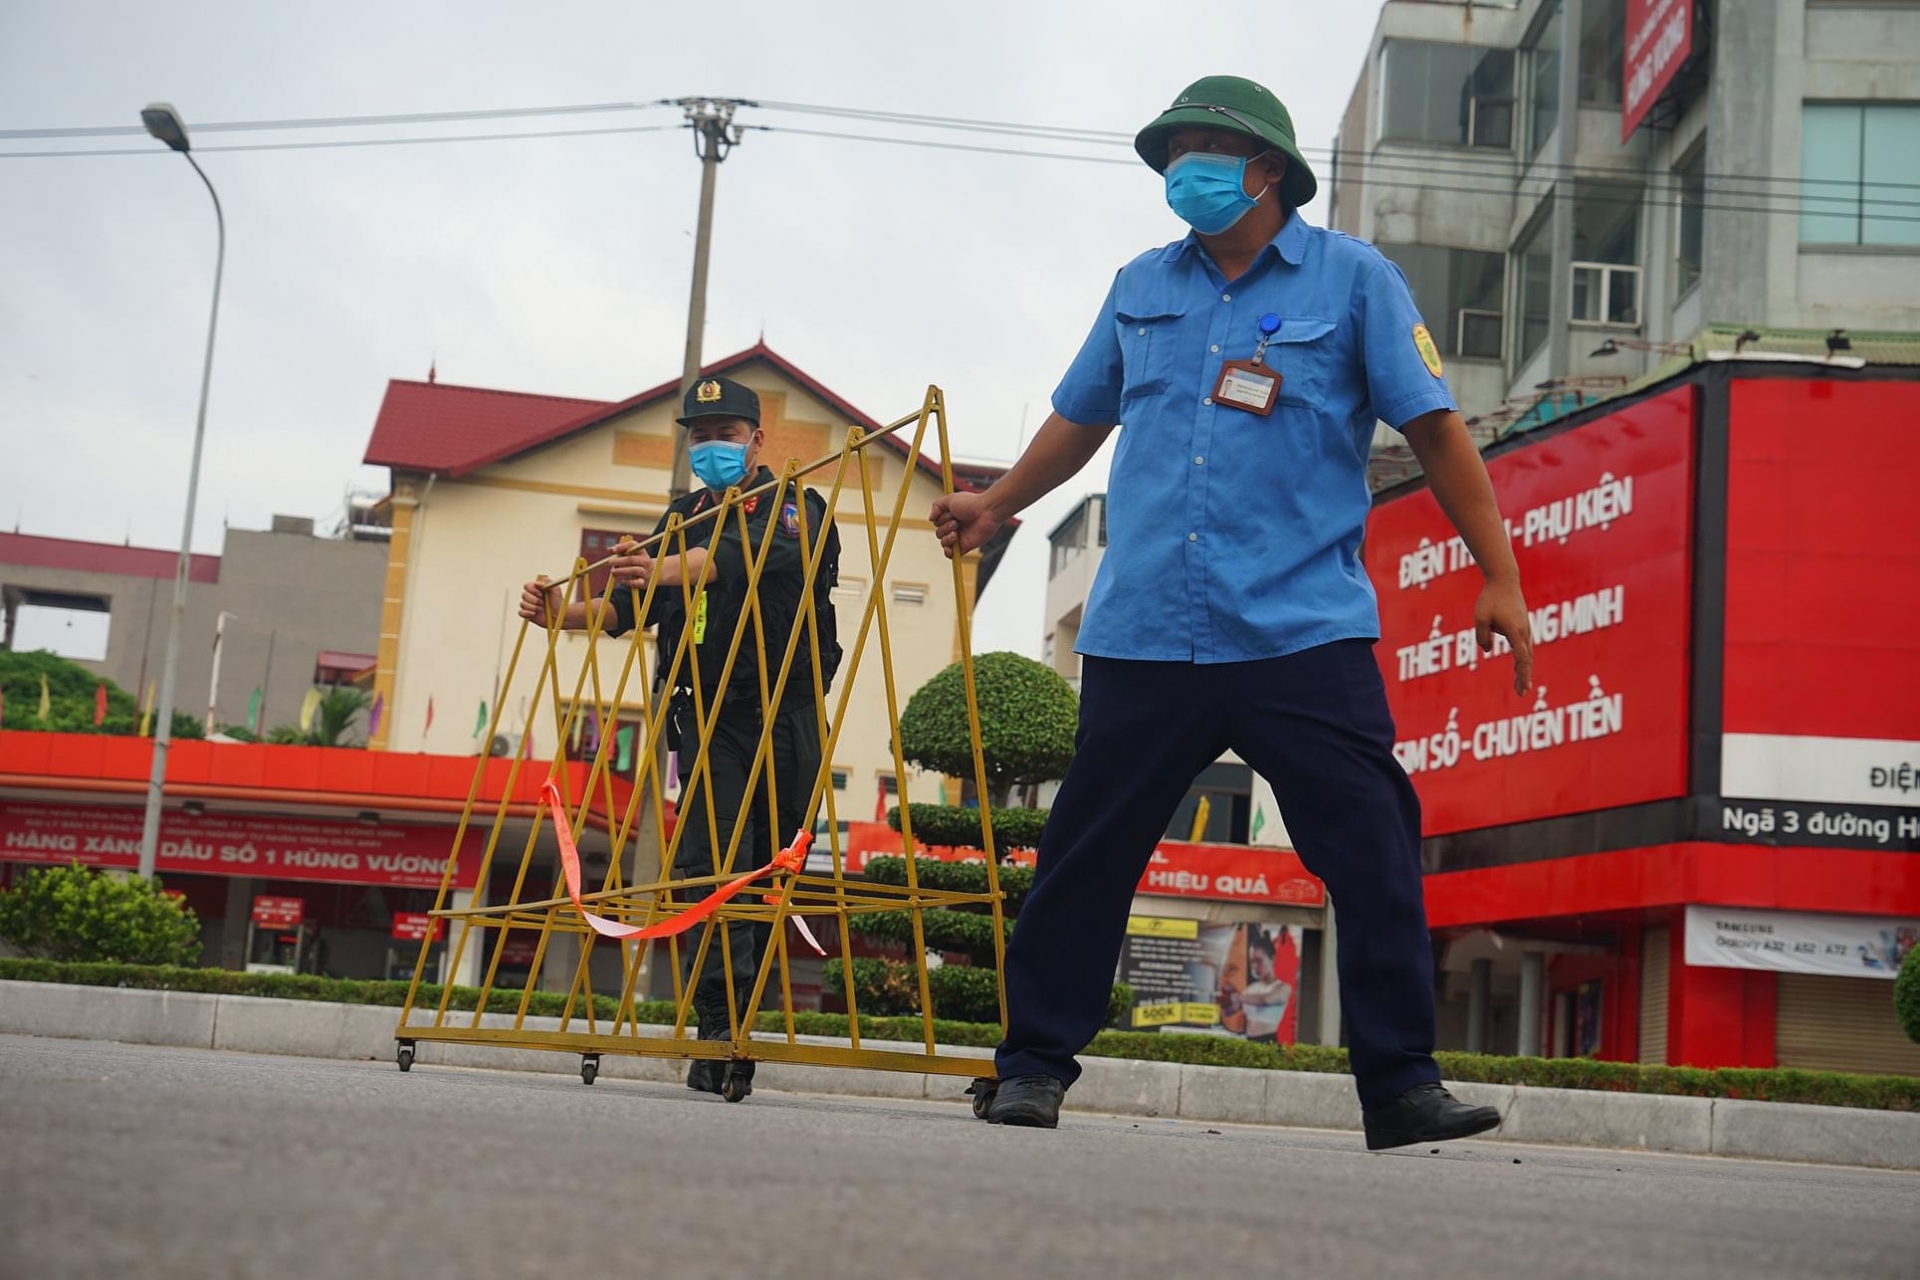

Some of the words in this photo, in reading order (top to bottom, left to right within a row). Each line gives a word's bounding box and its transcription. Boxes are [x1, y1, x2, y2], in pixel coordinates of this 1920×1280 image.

[1399, 537, 1445, 589] ĐIỆN
[1524, 498, 1573, 547] PHỤ
[1575, 471, 1633, 531] KIỆN
[1396, 615, 1455, 681] THIẾT
[1456, 627, 1477, 671] BỊ
[1560, 585, 1624, 638] MINH
[1429, 706, 1461, 770] SỐ
[1473, 686, 1563, 761] CHUYỂN
[1566, 674, 1623, 741] TIỀN
[6, 829, 77, 851] HÀNG
[160, 837, 213, 860] DẦU
[219, 841, 258, 864] SỐ
[265, 848, 277, 865] 1
[284, 848, 359, 870] HÙNG
[366, 852, 460, 876] VƯƠNG
[1722, 806, 1776, 836] Ngã
[1782, 811, 1800, 833] 3
[1807, 811, 1890, 843] đường
[1898, 815, 1920, 839] H
[1148, 869, 1209, 894] HIỆU
[1214, 873, 1269, 896] QUẢ
